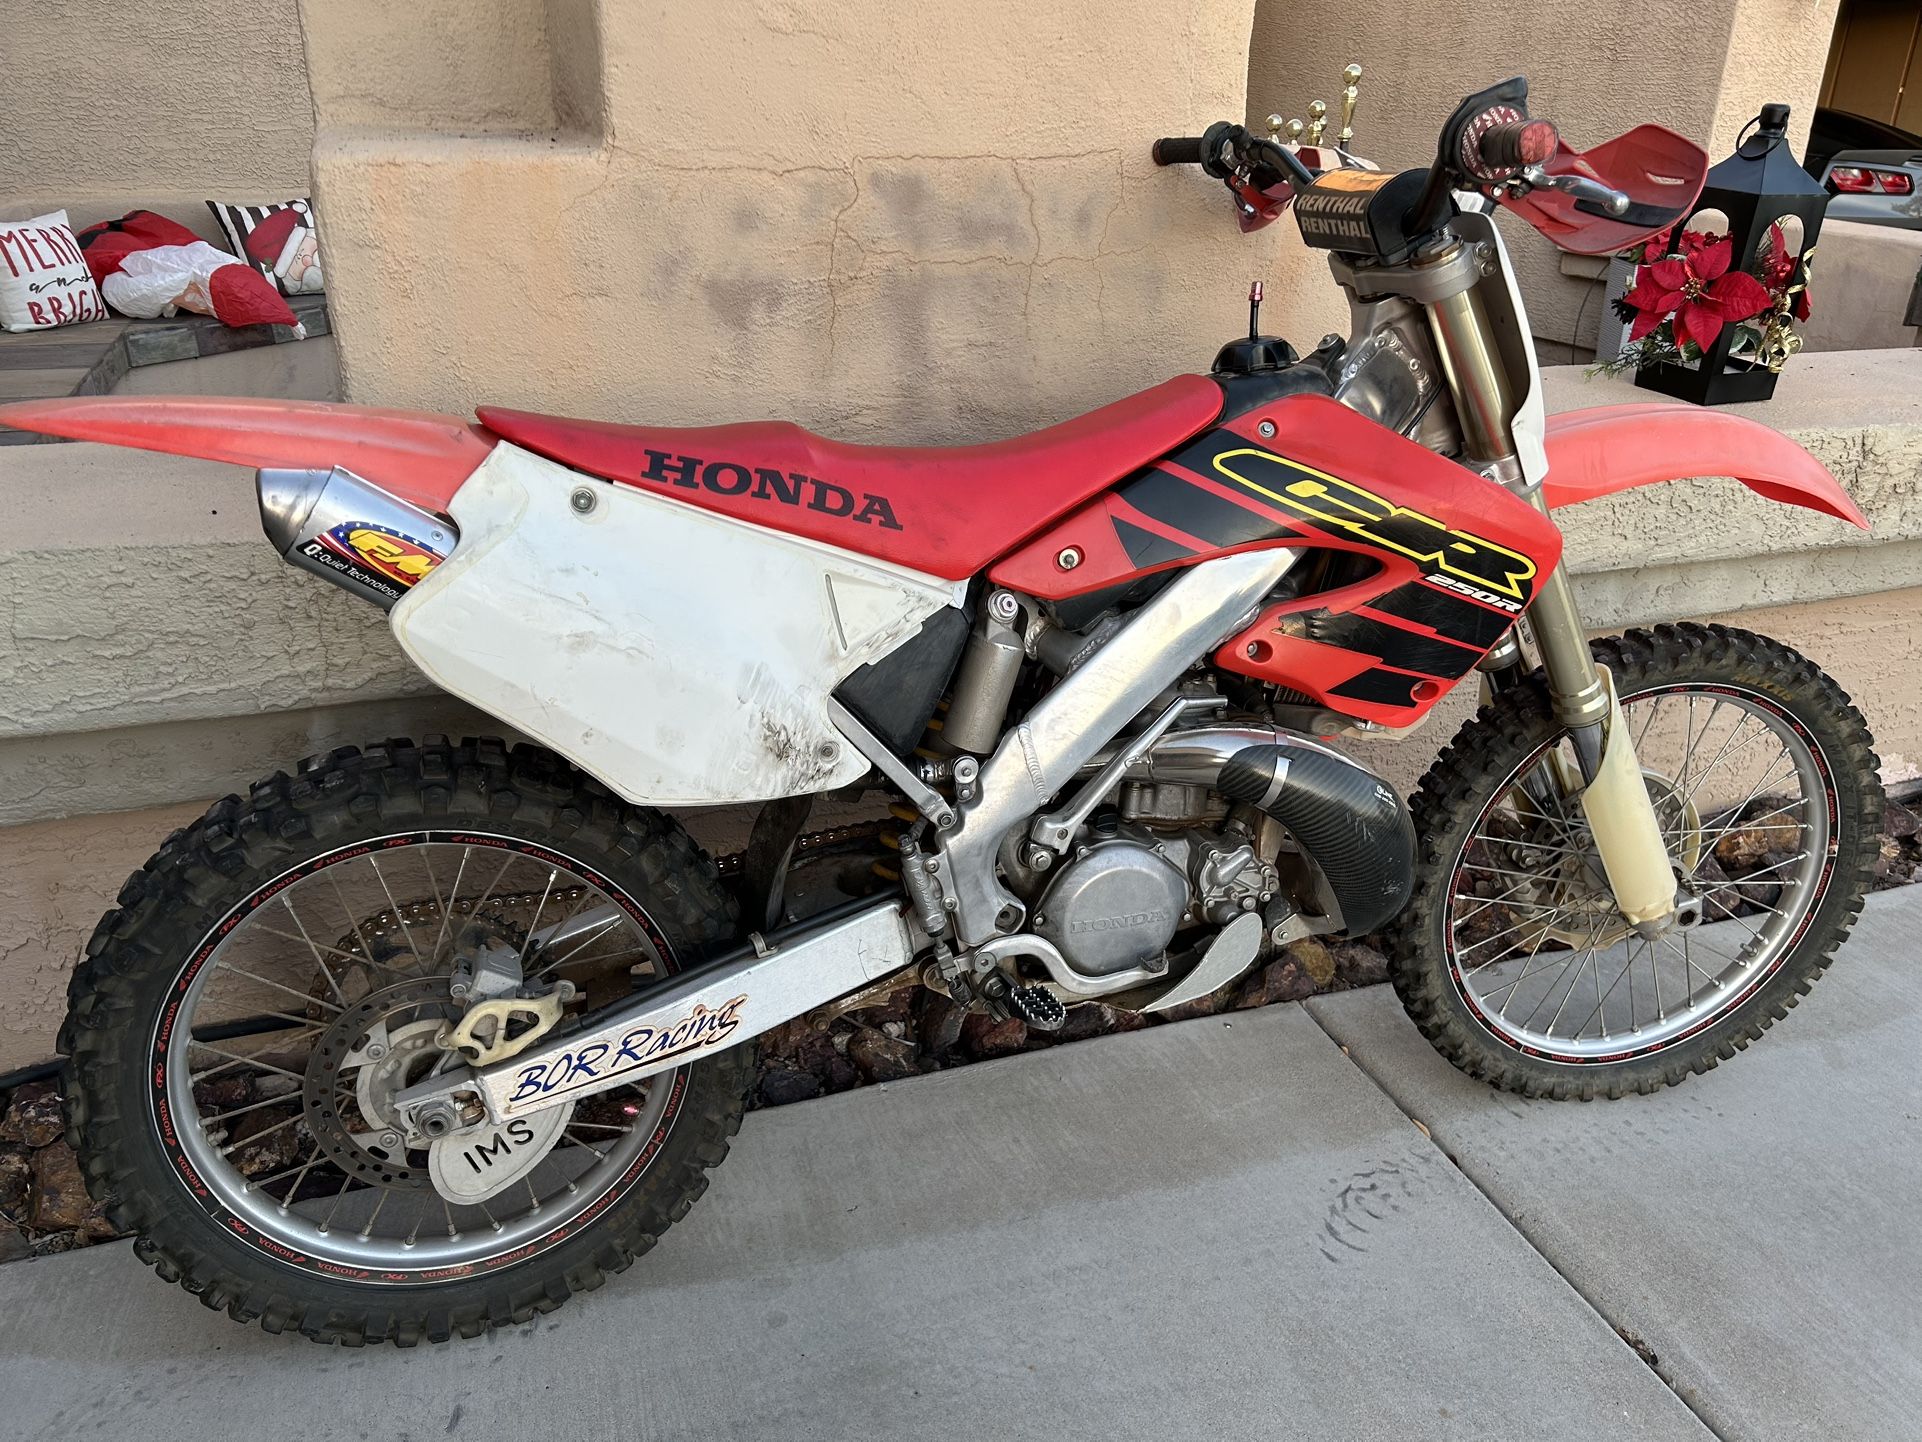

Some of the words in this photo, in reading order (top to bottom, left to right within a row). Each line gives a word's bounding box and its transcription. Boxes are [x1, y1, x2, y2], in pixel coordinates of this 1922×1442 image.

[1296, 194, 1368, 214] RENTHAL
[1300, 216, 1371, 238] RENTHAL
[29, 266, 93, 294] and
[27, 288, 105, 325] BRIGH
[640, 449, 903, 531] HONDA
[347, 566, 402, 599] Technology
[1424, 573, 1524, 613] 250R
[1070, 911, 1167, 934] HONDA
[509, 1044, 608, 1102] BOR
[611, 997, 748, 1068] Racing
[464, 1119, 534, 1174] IMS
